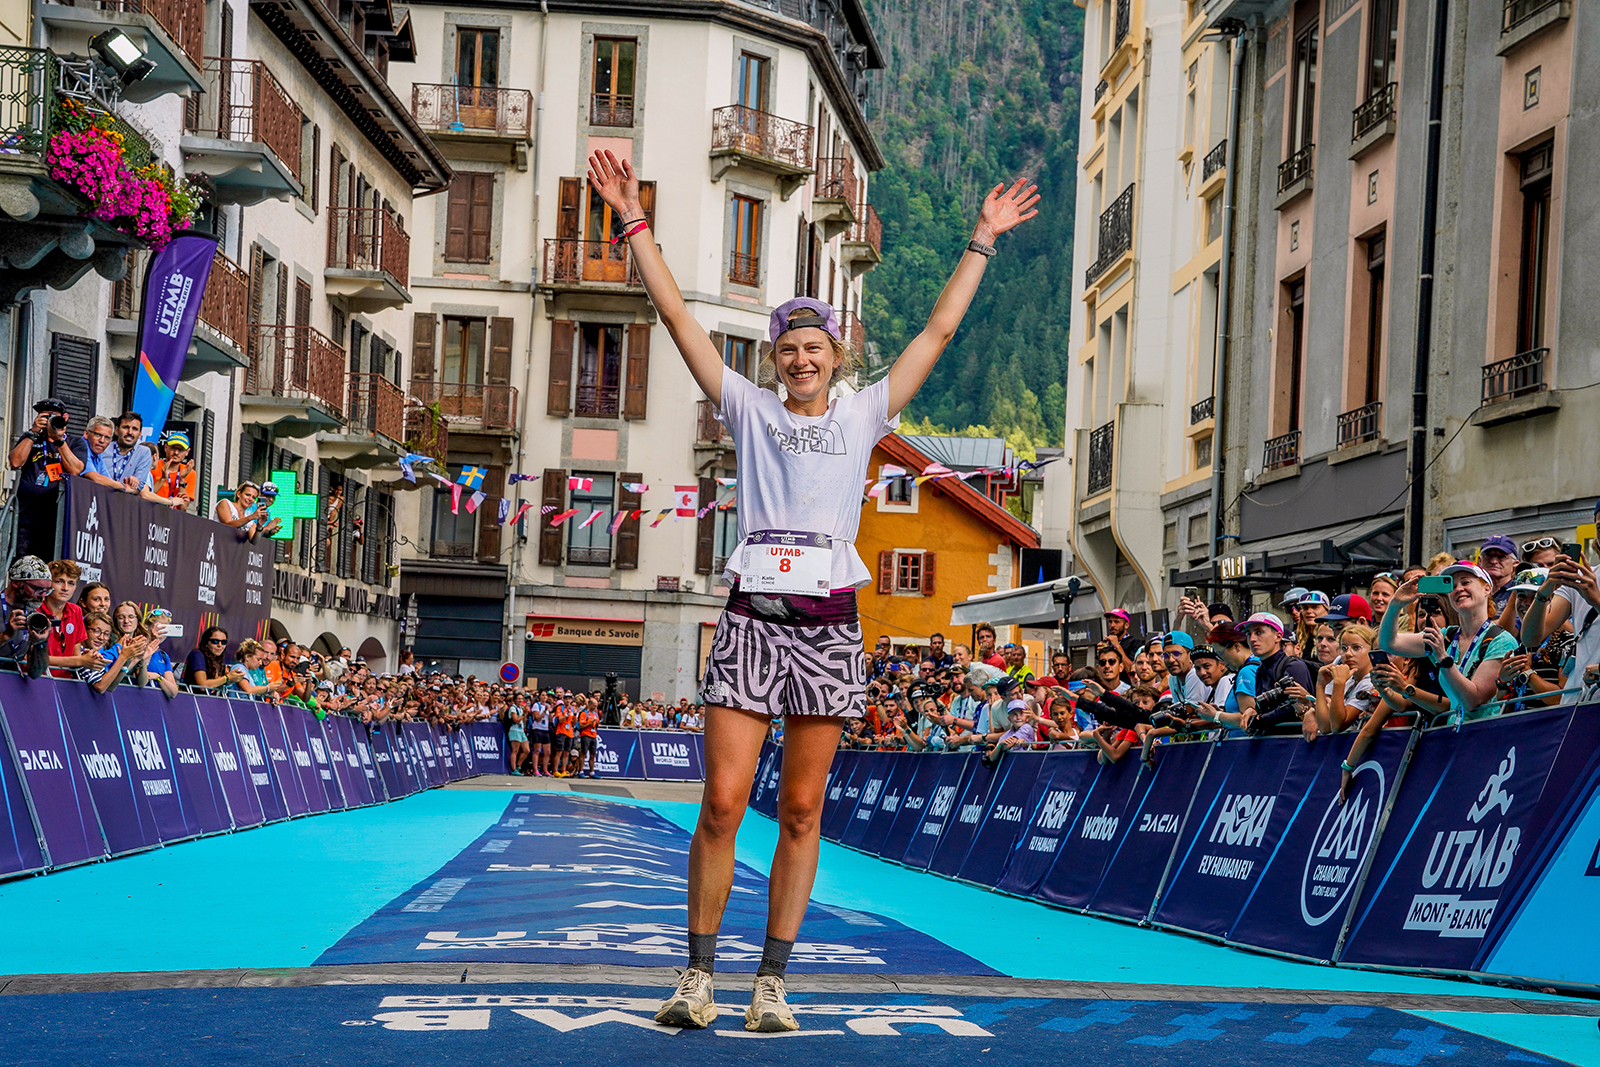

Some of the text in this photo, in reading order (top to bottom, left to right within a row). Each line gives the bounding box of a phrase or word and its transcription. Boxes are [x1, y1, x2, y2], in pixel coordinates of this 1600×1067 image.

[158, 273, 184, 335] UTMB
[172, 280, 191, 334] WORLD SERIES
[148, 523, 170, 544] SOMMET
[76, 531, 104, 564] UTMB
[144, 546, 168, 567] MONDIAL
[770, 547, 802, 557] UTMB
[779, 558, 791, 573] 8
[144, 569, 153, 586] DU
[557, 627, 640, 639] Banque de Savoie
[127, 729, 166, 770] HOKA
[473, 735, 499, 751] HOKA
[651, 742, 688, 757] UTMB
[20, 750, 64, 770] DACIA
[81, 740, 122, 779] wahoo
[177, 748, 202, 764] DACIA
[993, 804, 1022, 822] DACIA
[1081, 804, 1119, 842] wahoo
[1209, 794, 1276, 847] HOKA
[1139, 814, 1180, 833] DACIA
[1422, 823, 1521, 891] UTMB
[1198, 855, 1254, 880] FLY HUMAN FLY
[1312, 864, 1350, 884] CHAMONIX
[1311, 885, 1339, 898] MONT-BLANC
[1409, 902, 1493, 931] MONT-BLANC
